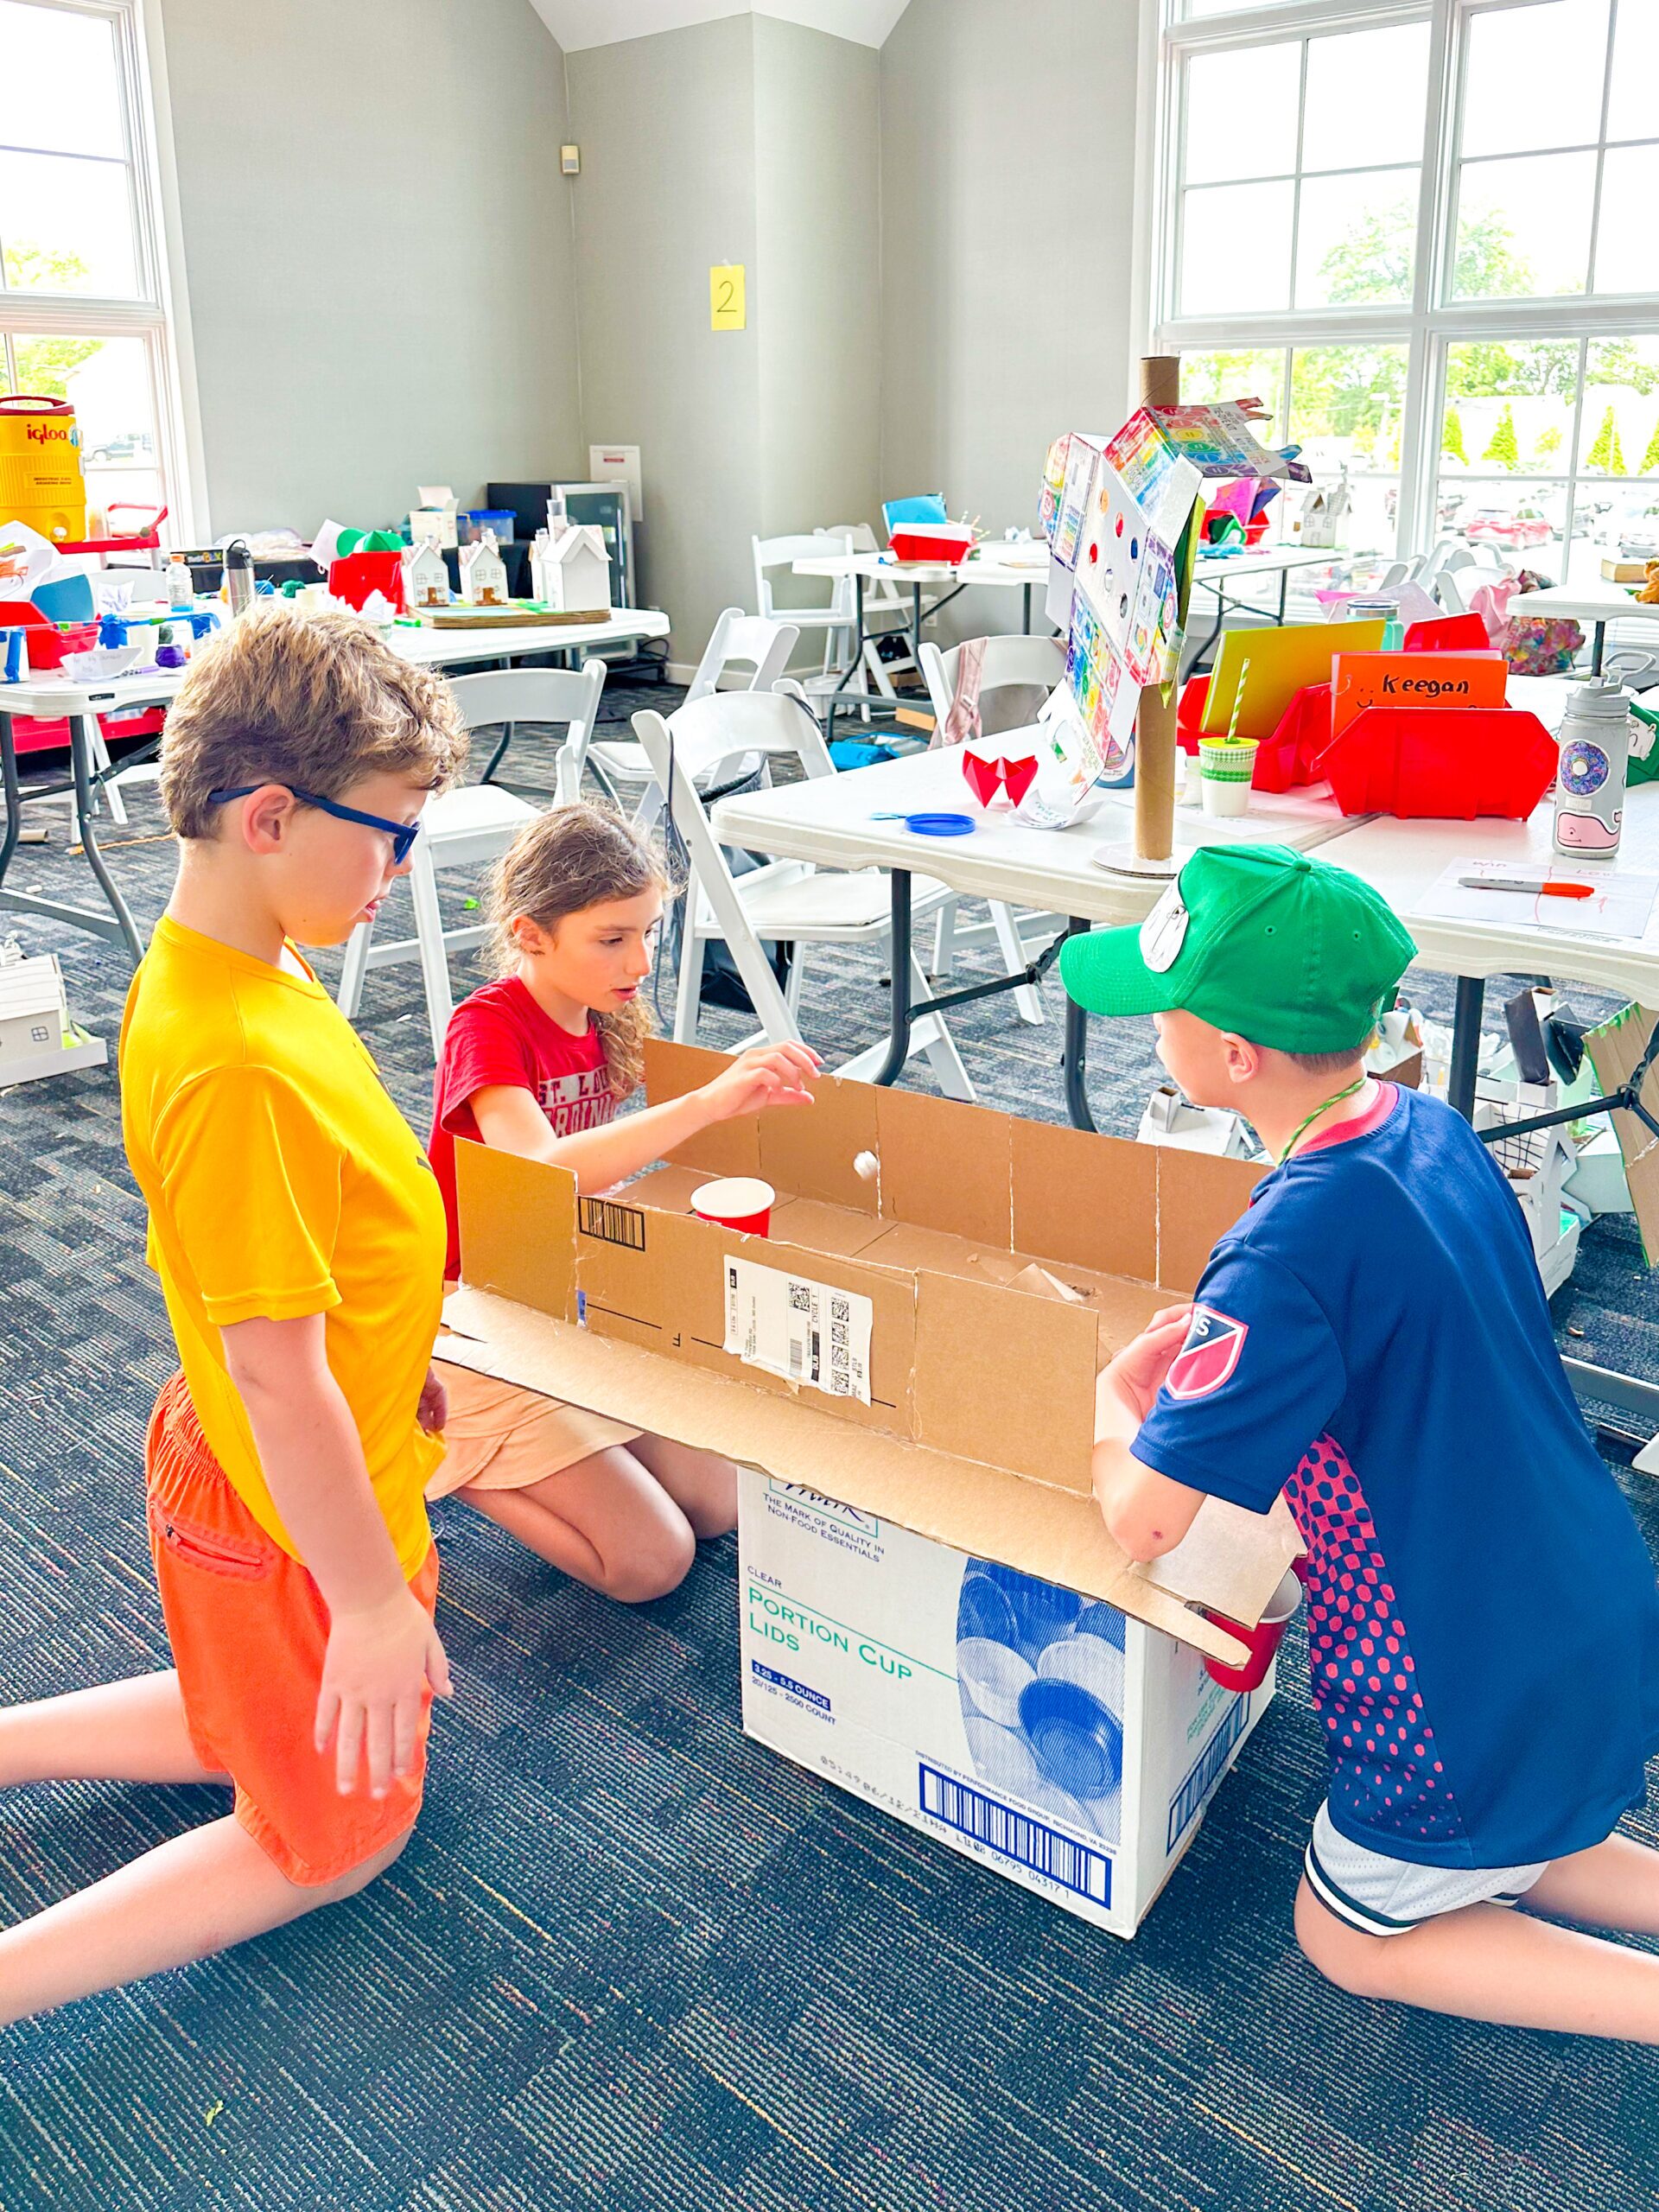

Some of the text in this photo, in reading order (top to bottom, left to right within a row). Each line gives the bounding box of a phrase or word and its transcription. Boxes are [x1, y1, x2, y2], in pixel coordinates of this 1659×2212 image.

[716, 280, 737, 313] 2
[27, 423, 67, 445] igloo
[1382, 674, 1469, 698] Keegan
[763, 1493, 885, 1555] THE MARK OF QUALITY IN
[767, 1505, 880, 1563] NON-FOOD ESSENTIALS
[747, 1566, 782, 1589] CLEAR
[749, 1586, 912, 1679] PORTION CUP
[750, 1612, 799, 1651] LIDS
[754, 1663, 772, 1680] 3.25
[779, 1676, 793, 1690] 5.5
[795, 1684, 830, 1709] OUNCE
[785, 1694, 804, 1708] 2500
[805, 1704, 836, 1726] COUNT
[915, 1750, 952, 1772] DISTRIBUTED
[953, 1769, 962, 1777] BY
[963, 1774, 1007, 1801] PERFORMANCE
[1008, 1797, 1026, 1810] FOOD
[991, 1851, 1023, 1873] 06795
[1028, 1870, 1061, 1892] 04317
